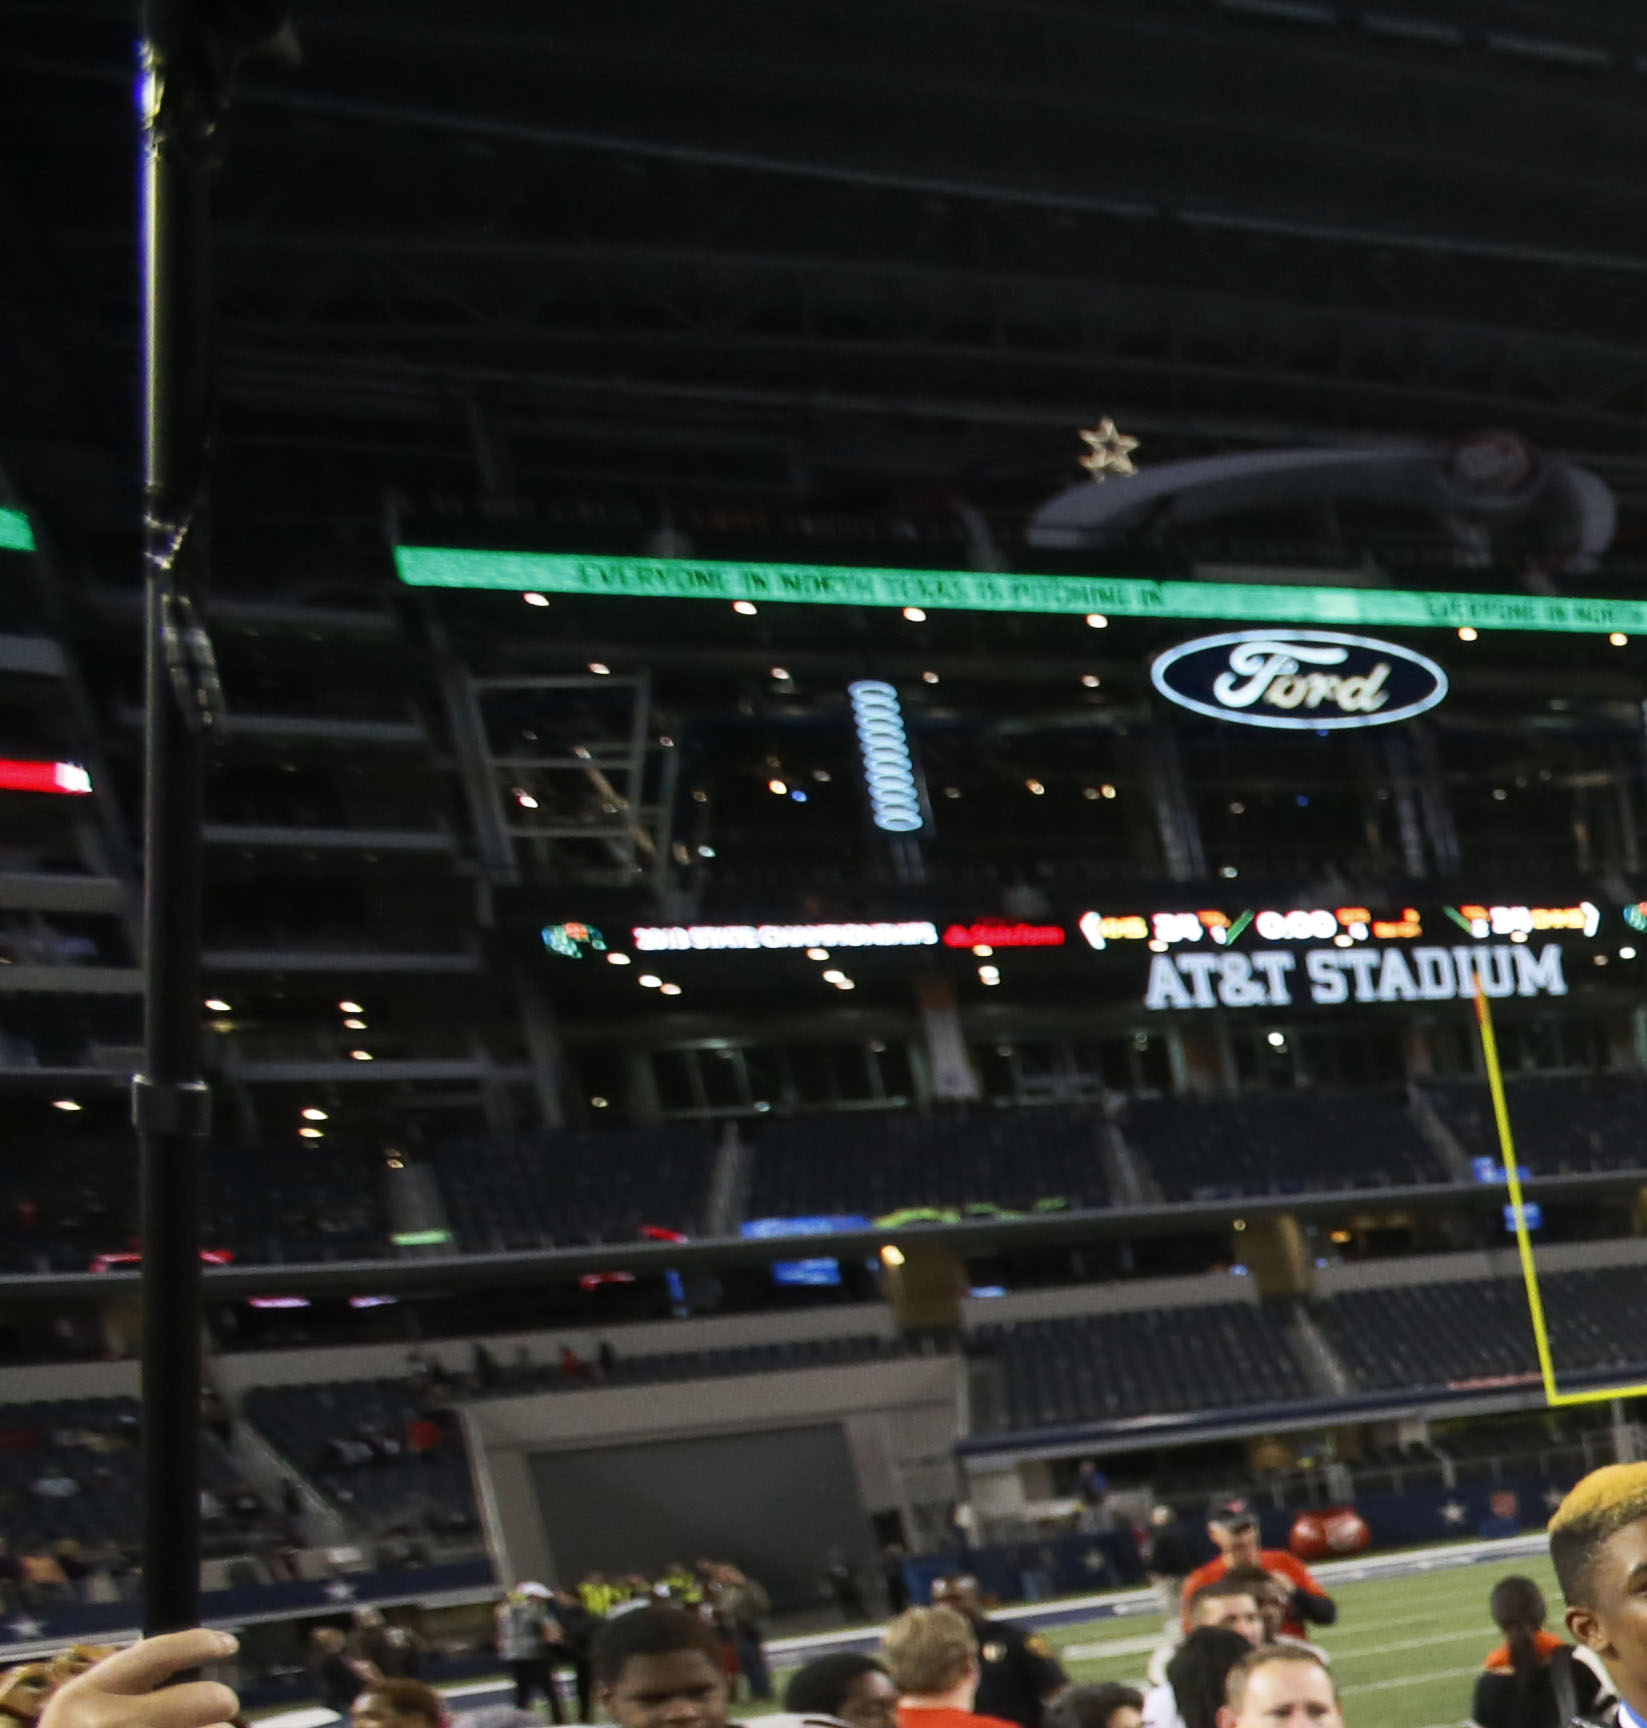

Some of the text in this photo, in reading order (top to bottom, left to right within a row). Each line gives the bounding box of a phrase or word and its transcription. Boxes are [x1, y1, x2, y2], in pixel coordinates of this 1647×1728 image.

[1213, 640, 1393, 713] Ford
[1144, 942, 1570, 1012] AT&T STADIUM
